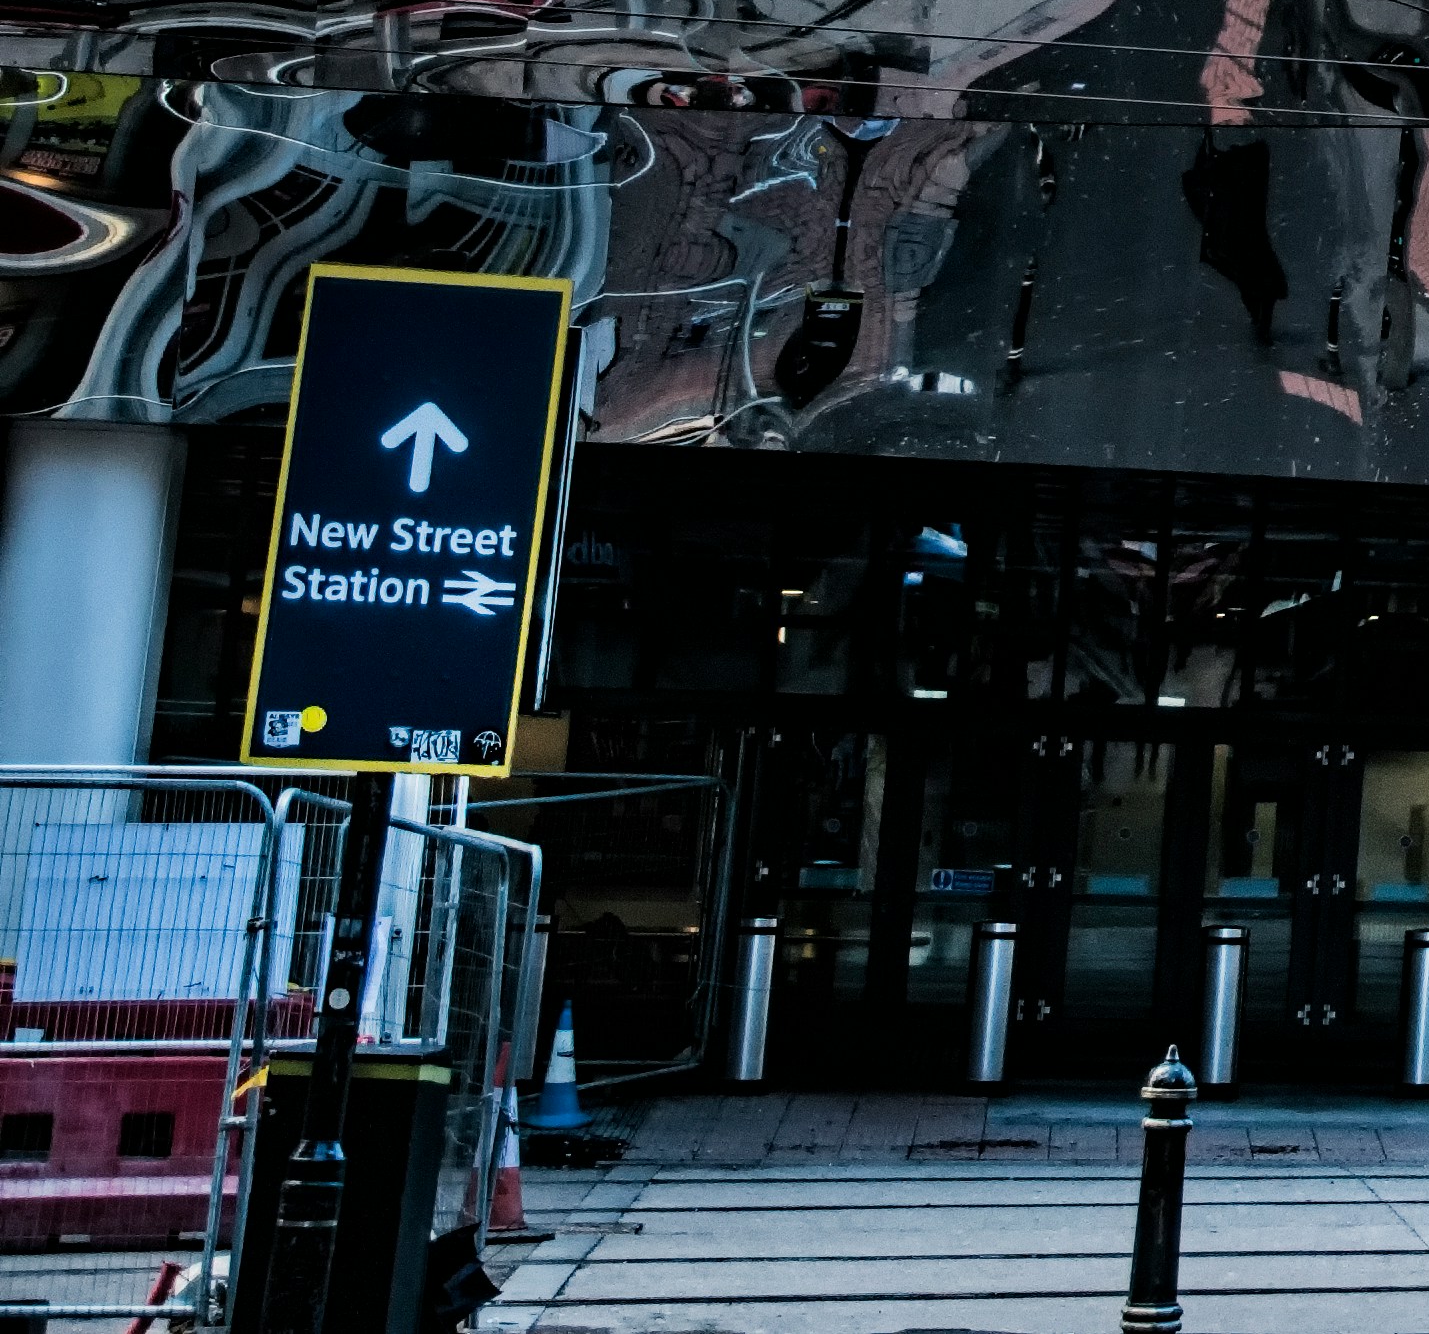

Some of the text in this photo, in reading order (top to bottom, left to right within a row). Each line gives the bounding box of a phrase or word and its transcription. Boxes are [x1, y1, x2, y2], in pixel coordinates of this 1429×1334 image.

[289, 512, 518, 557] New Street
[281, 565, 430, 605] Station
